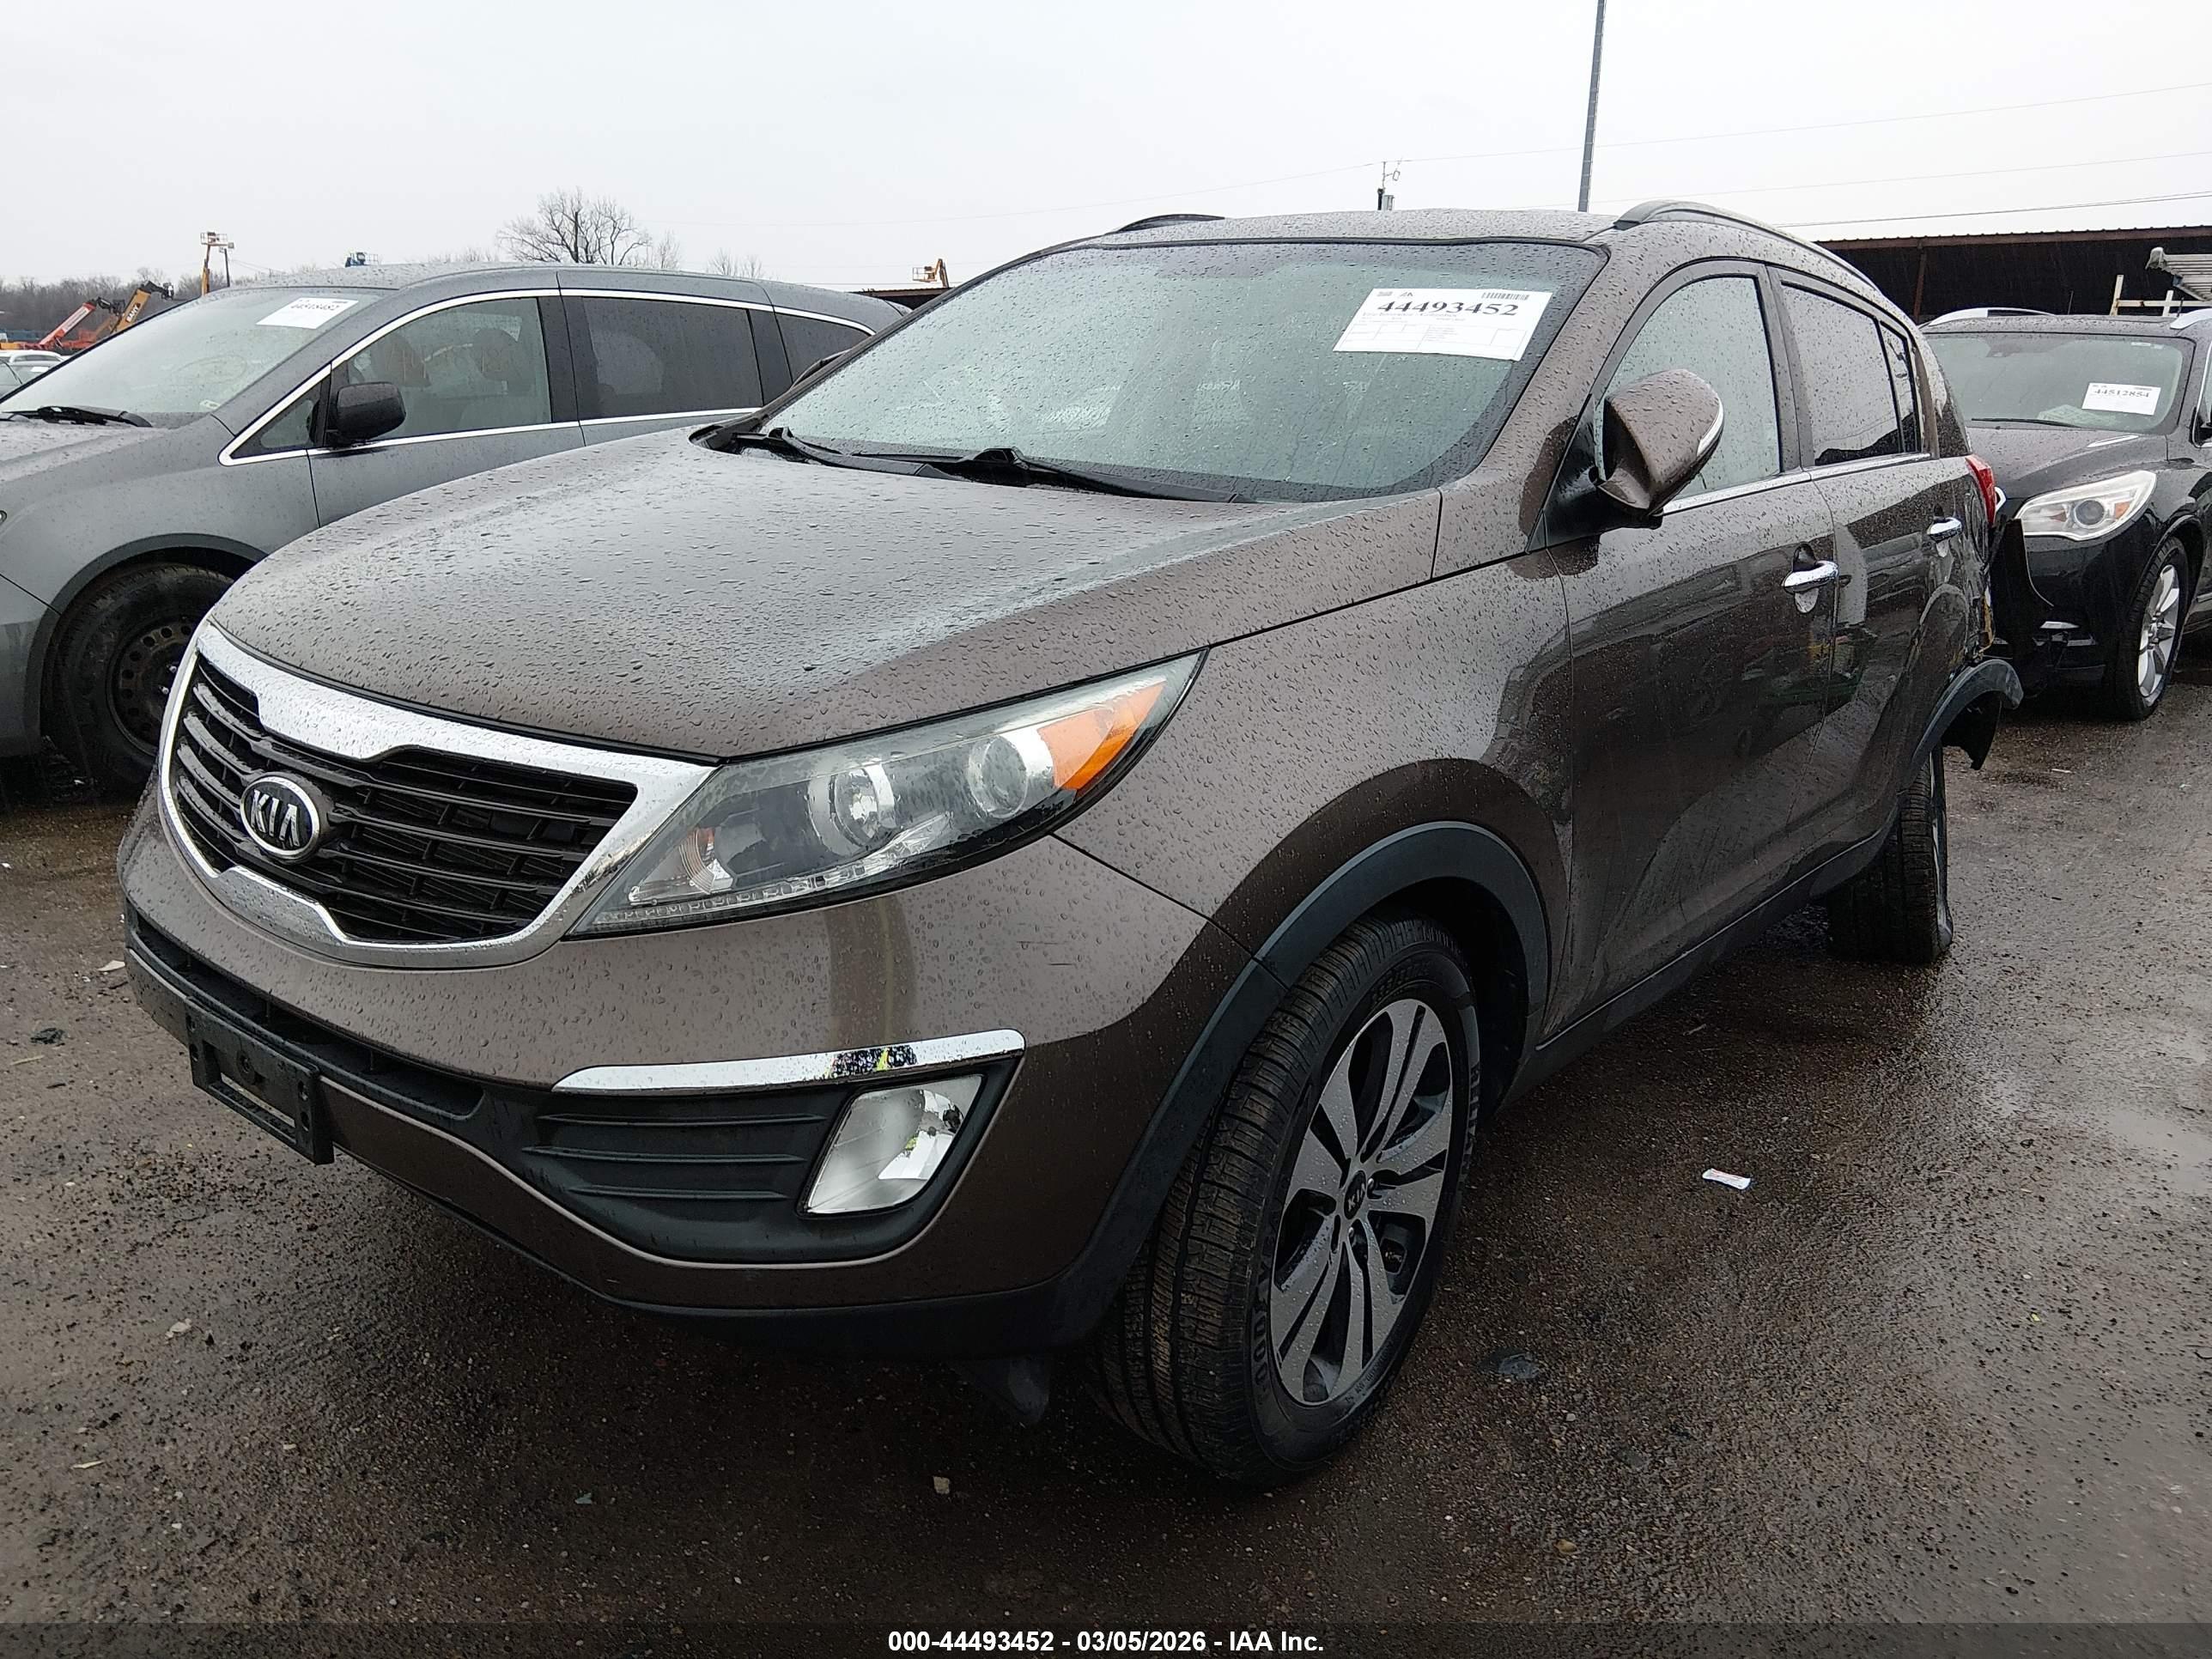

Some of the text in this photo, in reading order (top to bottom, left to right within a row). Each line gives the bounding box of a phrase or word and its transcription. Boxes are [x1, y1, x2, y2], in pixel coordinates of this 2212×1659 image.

[1377, 301, 1519, 316] 44493452
[251, 788, 301, 847] KIA
[1347, 1182, 1365, 1212] KIA
